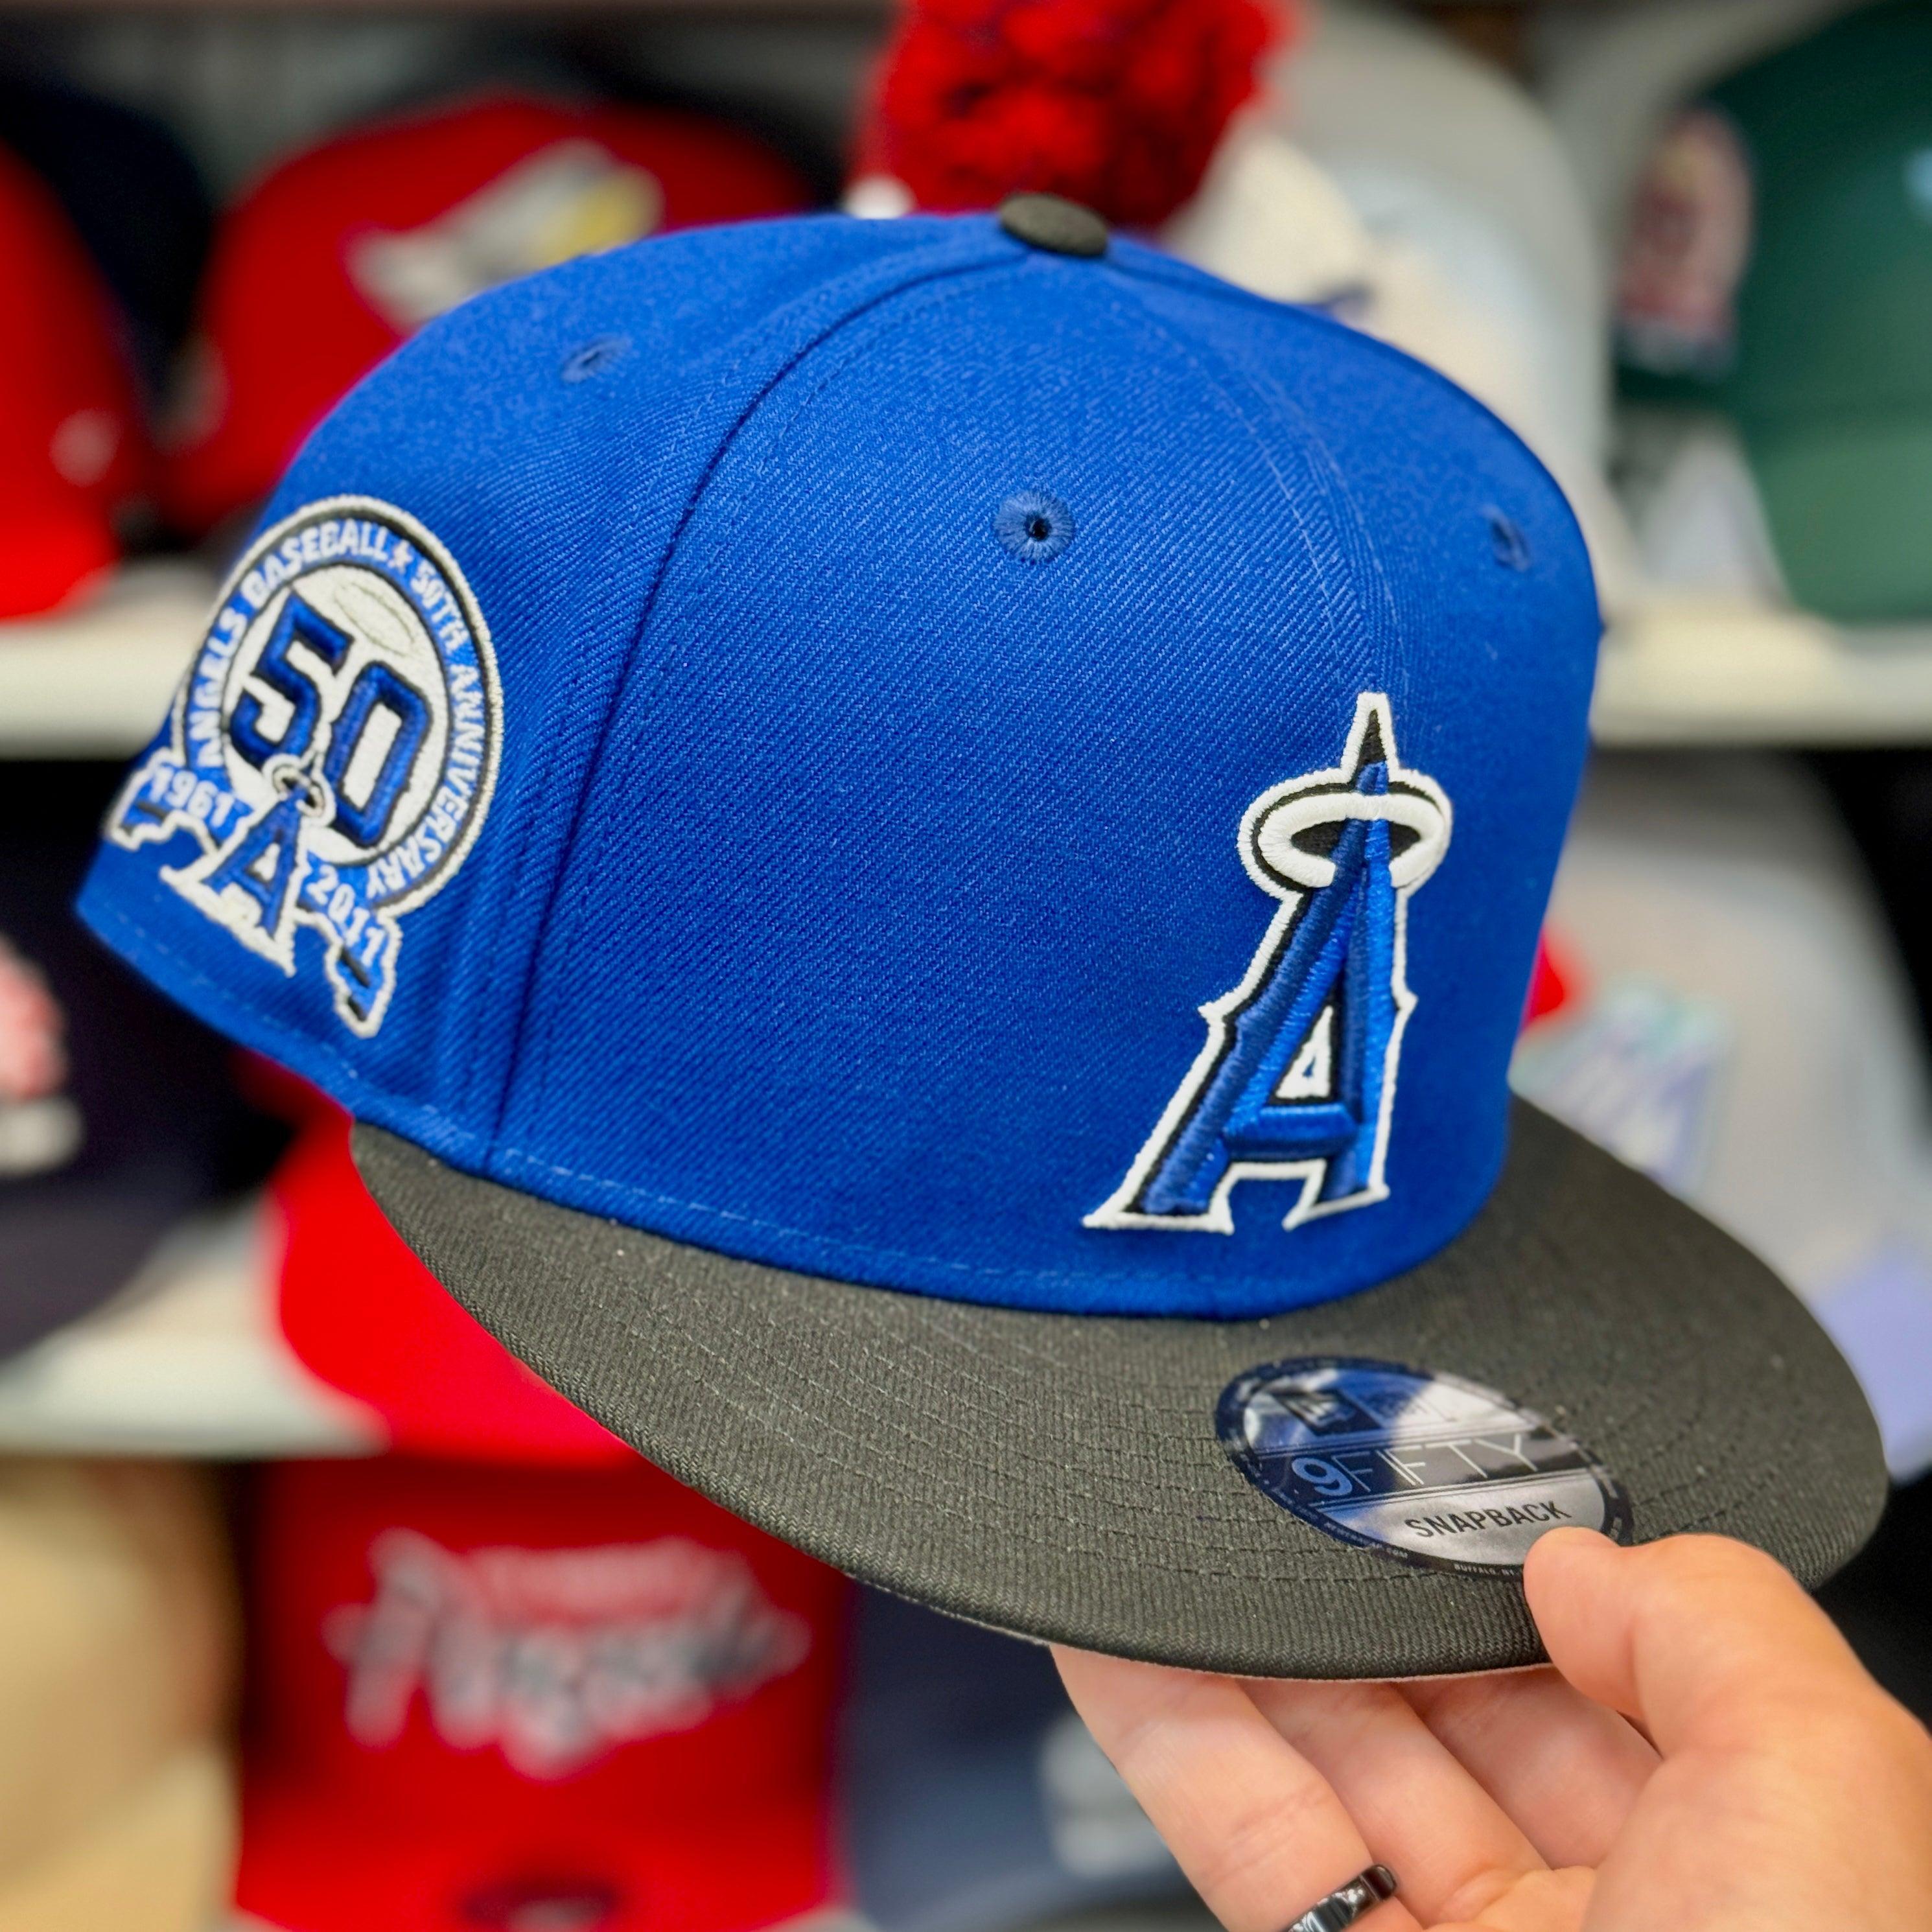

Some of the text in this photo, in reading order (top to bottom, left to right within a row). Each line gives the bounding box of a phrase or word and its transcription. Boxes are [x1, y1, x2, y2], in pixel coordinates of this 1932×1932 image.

[188, 518, 390, 768] ANGELS BASEBALL
[229, 590, 435, 850] 50
[367, 560, 487, 898] 50TH ANNIVERSARY
[147, 762, 236, 828] 1961
[306, 864, 388, 970] 2011
[1083, 693, 1452, 1233] A
[1291, 1433, 1539, 1496] 9FIFTY
[1404, 1499, 1572, 1539] SNAPBACK
